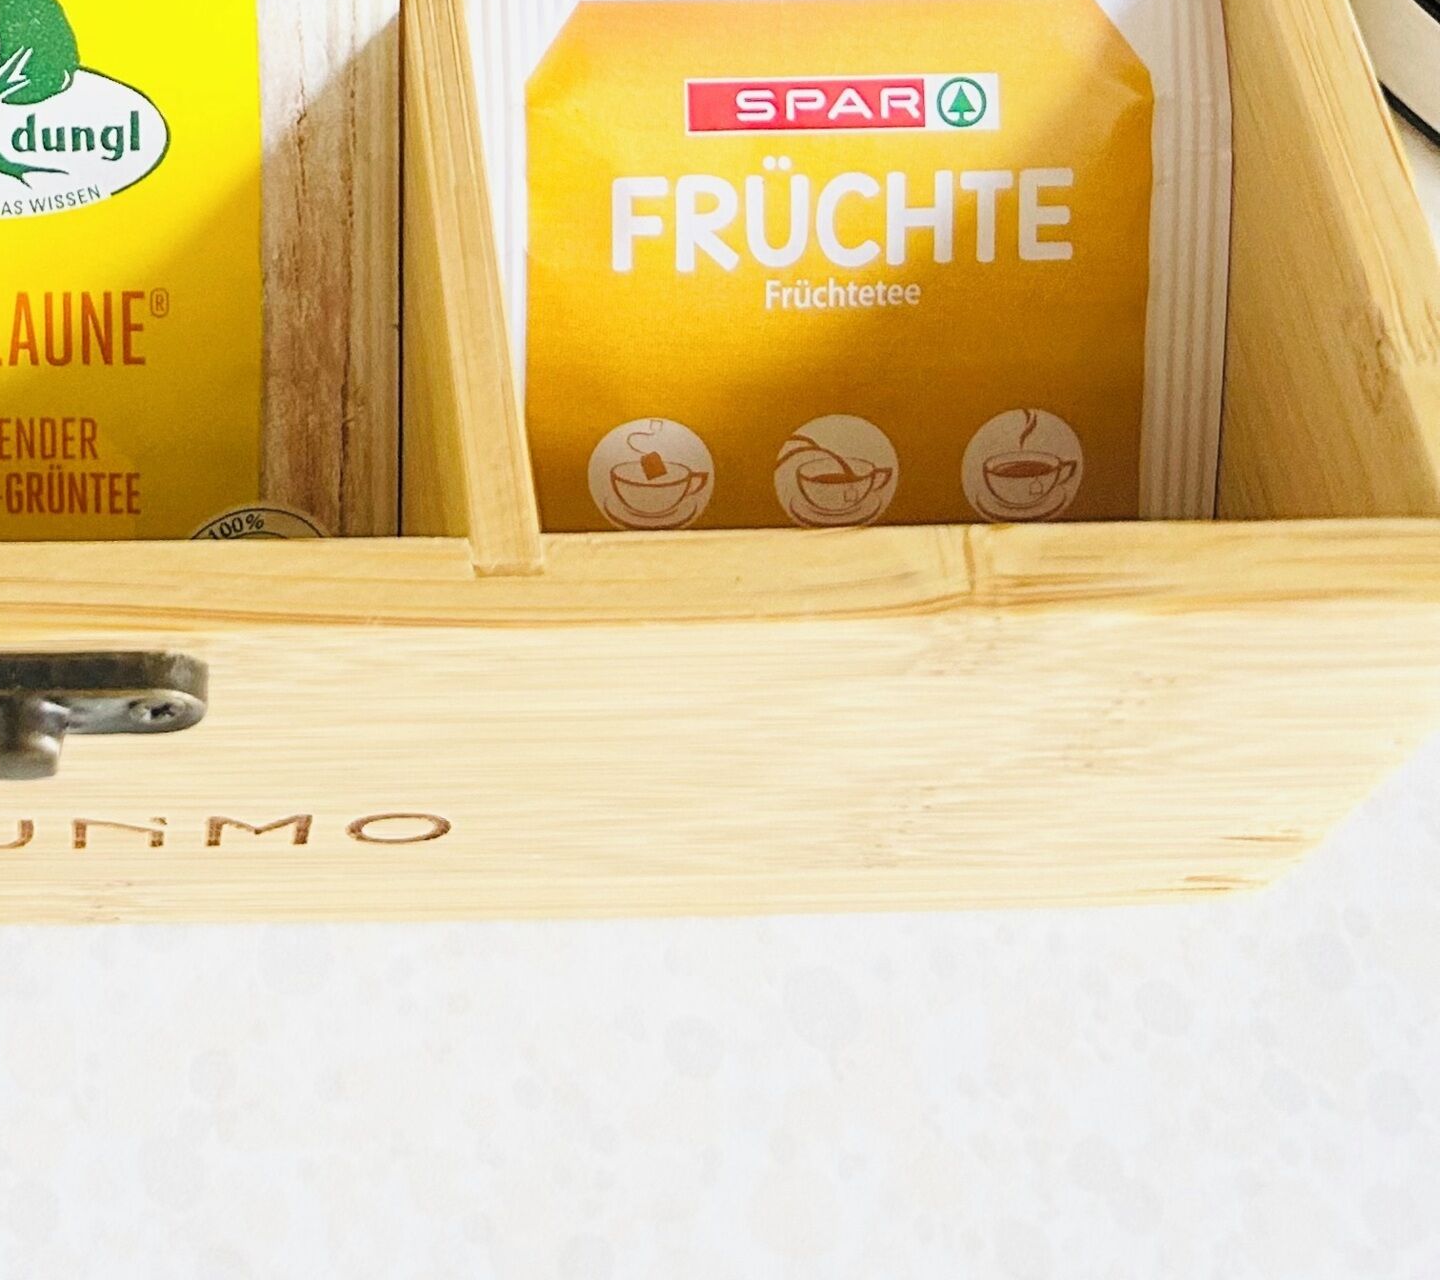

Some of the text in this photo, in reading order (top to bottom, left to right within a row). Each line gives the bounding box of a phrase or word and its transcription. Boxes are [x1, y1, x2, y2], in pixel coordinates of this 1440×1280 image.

[734, 86, 923, 122] SPAR
[10, 109, 141, 162] dungl
[28, 184, 103, 214] WISSEN
[610, 154, 1076, 274] FRÜCHTE
[763, 277, 924, 310] Früchtetee
